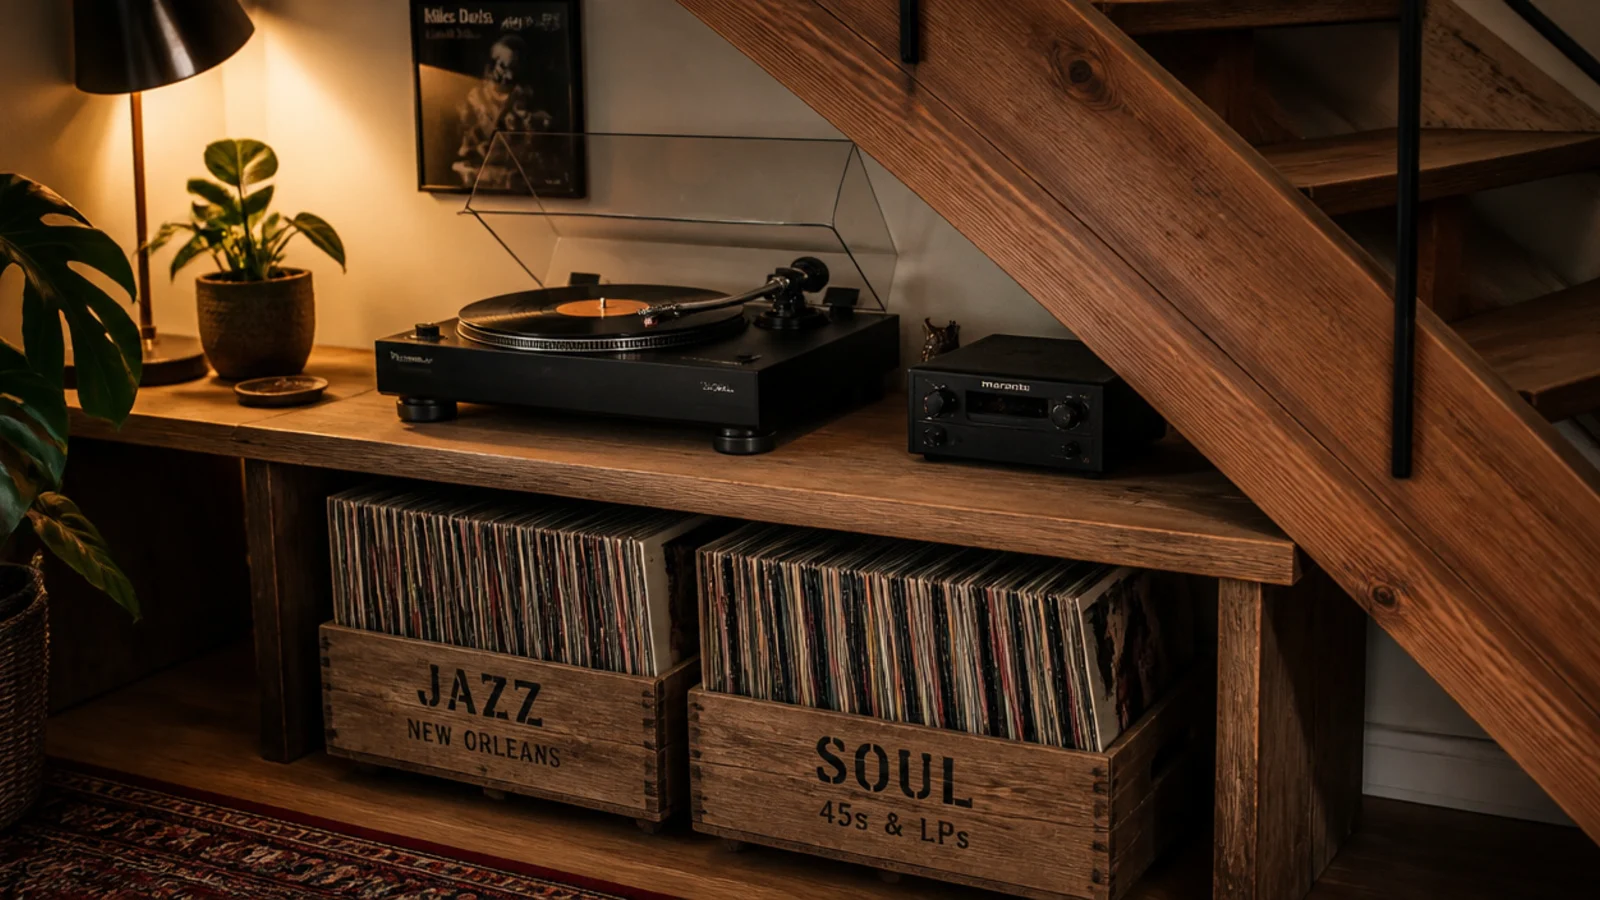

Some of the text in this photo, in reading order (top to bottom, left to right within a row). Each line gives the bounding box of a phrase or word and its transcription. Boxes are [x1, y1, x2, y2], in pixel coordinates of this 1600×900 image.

[416, 663, 543, 728] JAZZ
[407, 718, 561, 768] NEW ORLEANS
[816, 736, 973, 809] SOUL
[819, 800, 969, 849] 45s & LPs
